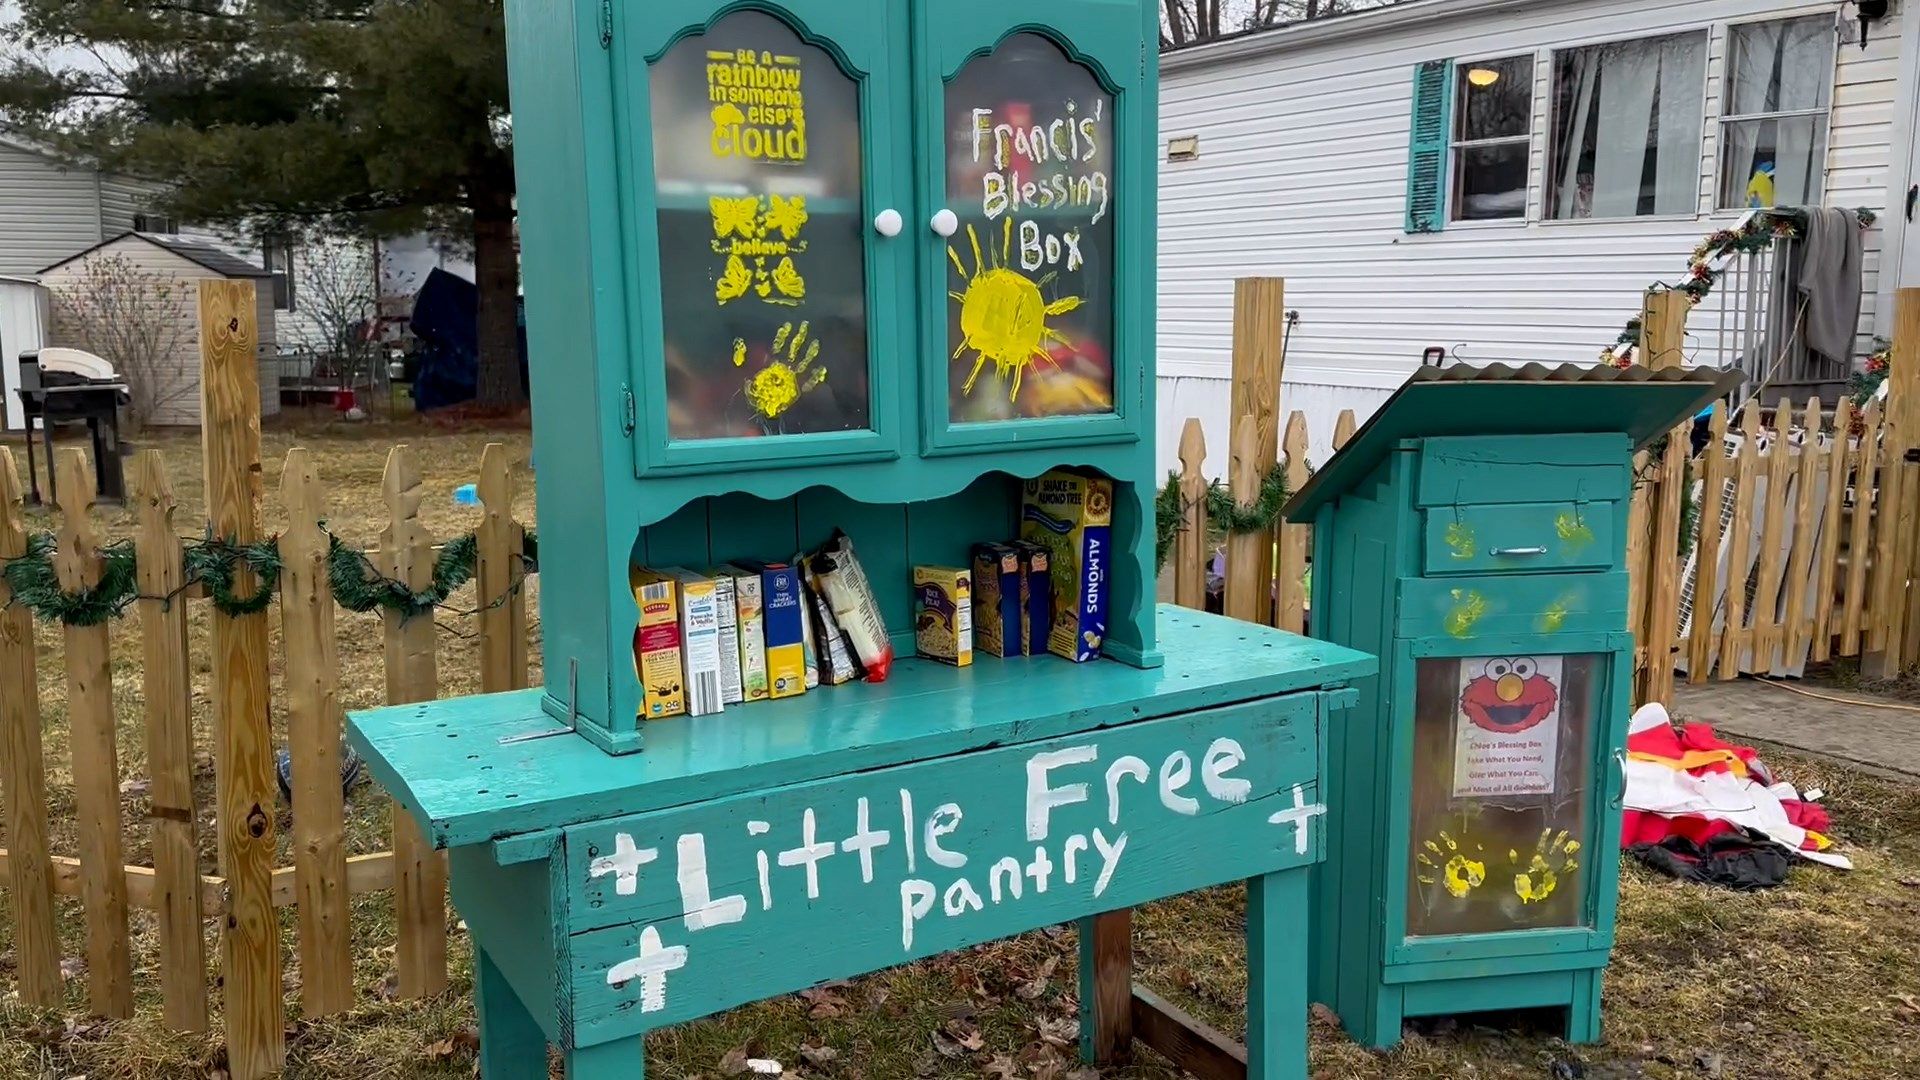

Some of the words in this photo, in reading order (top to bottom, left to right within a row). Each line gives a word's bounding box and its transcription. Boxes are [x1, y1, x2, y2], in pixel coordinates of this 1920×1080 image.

[707, 63, 801, 89] rainbow
[709, 84, 727, 101] in
[728, 87, 803, 107] someone
[711, 122, 806, 160] cloud
[973, 98, 1102, 170] Francis'
[983, 170, 1108, 225] Blessing
[732, 237, 787, 255] believe
[1020, 220, 1084, 272] Box
[1087, 538, 1100, 614] ALMONDS
[769, 600, 797, 609] CRACKERS
[1470, 742, 1496, 750] Chloe's
[1497, 741, 1527, 749] Blessing
[676, 787, 968, 931] Little
[1025, 737, 1252, 840] Free
[900, 827, 1127, 952] pantry
